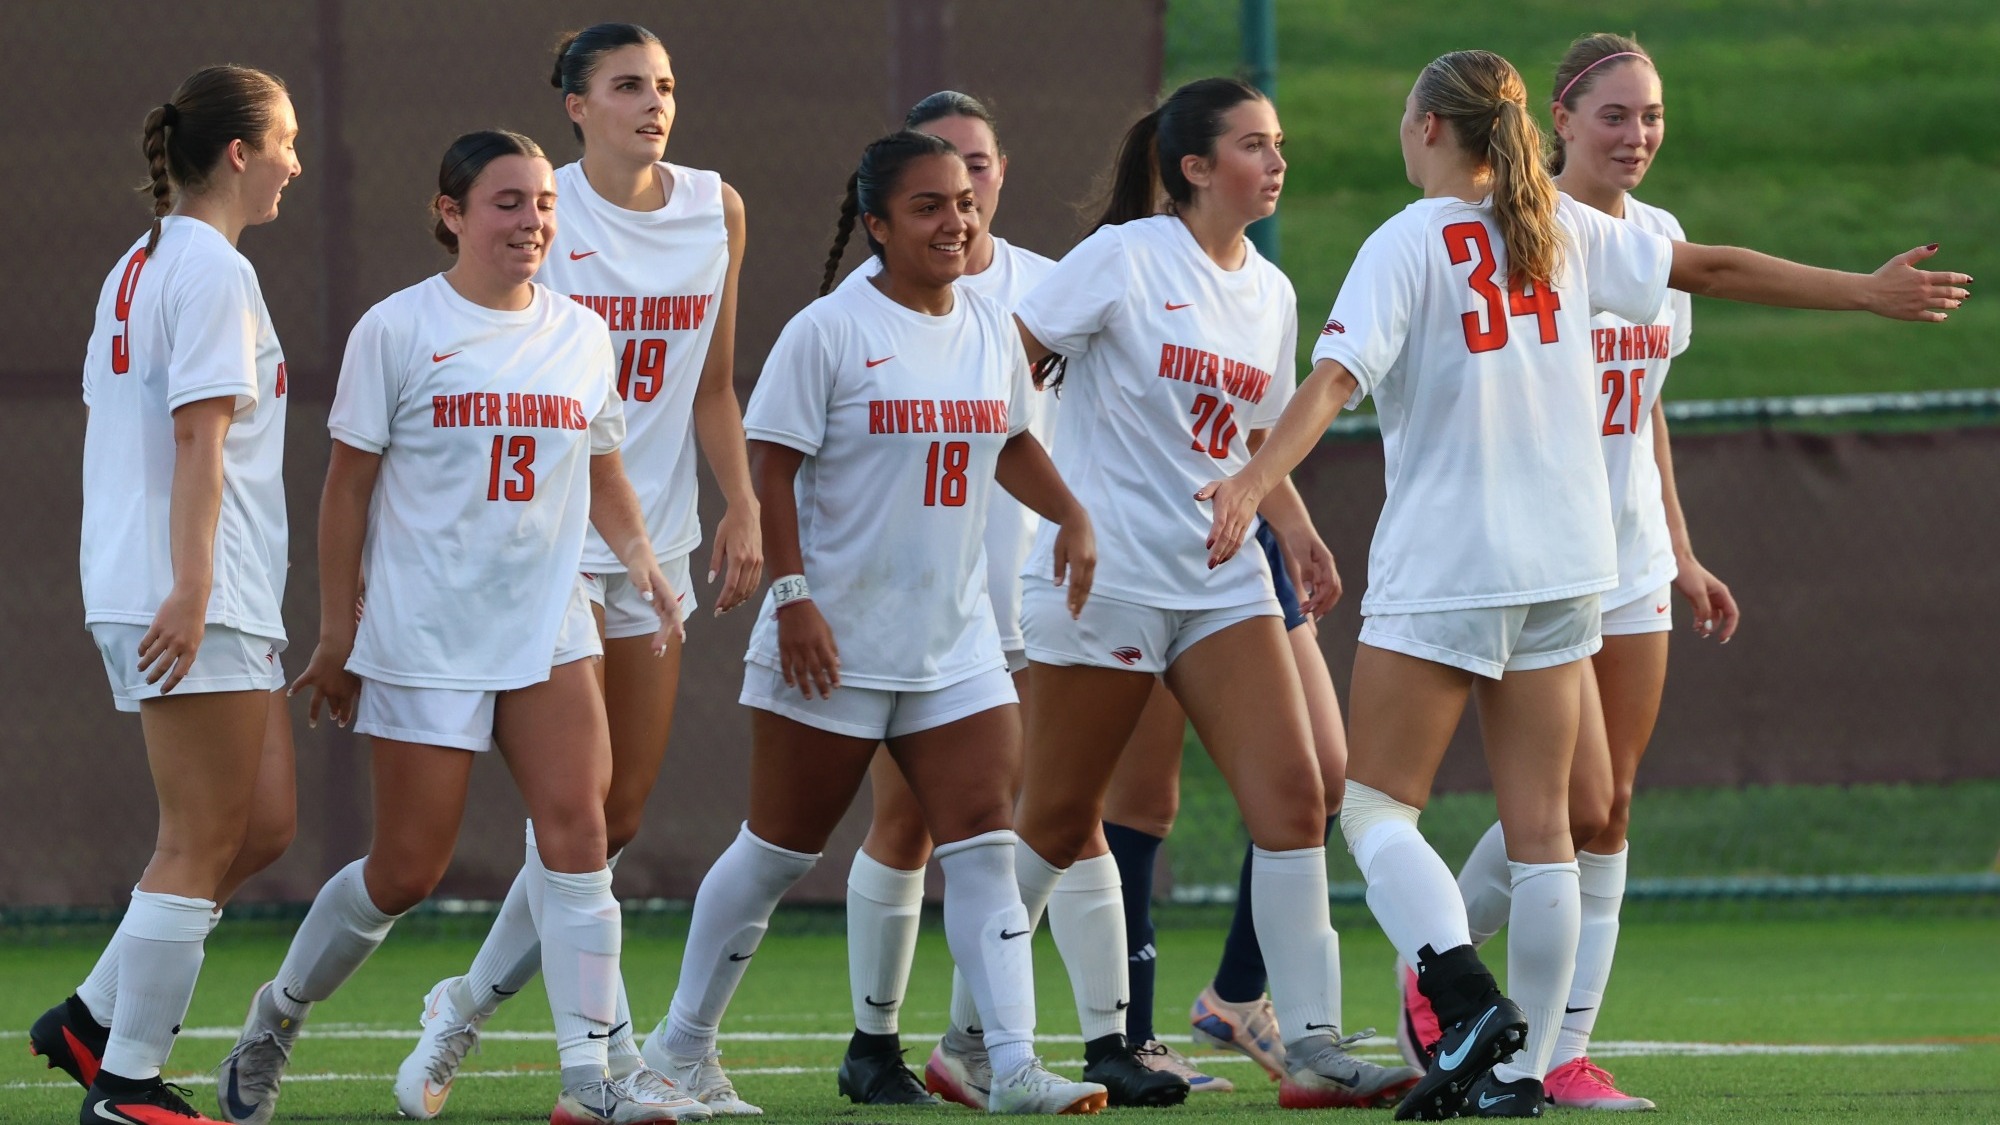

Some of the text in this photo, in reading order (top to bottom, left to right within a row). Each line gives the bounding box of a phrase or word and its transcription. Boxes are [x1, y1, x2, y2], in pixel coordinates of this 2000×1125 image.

[112, 247, 149, 375] 9
[570, 294, 713, 331] VER HAWK
[1442, 221, 1561, 354] 34
[617, 338, 667, 402] 19
[1158, 343, 1219, 388] RIVER
[432, 392, 588, 430] RIVER HAWKS
[869, 400, 1008, 434] RIVER HAWKS
[1190, 393, 1238, 459] 20
[487, 435, 536, 501] 13
[924, 441, 970, 506] 18
